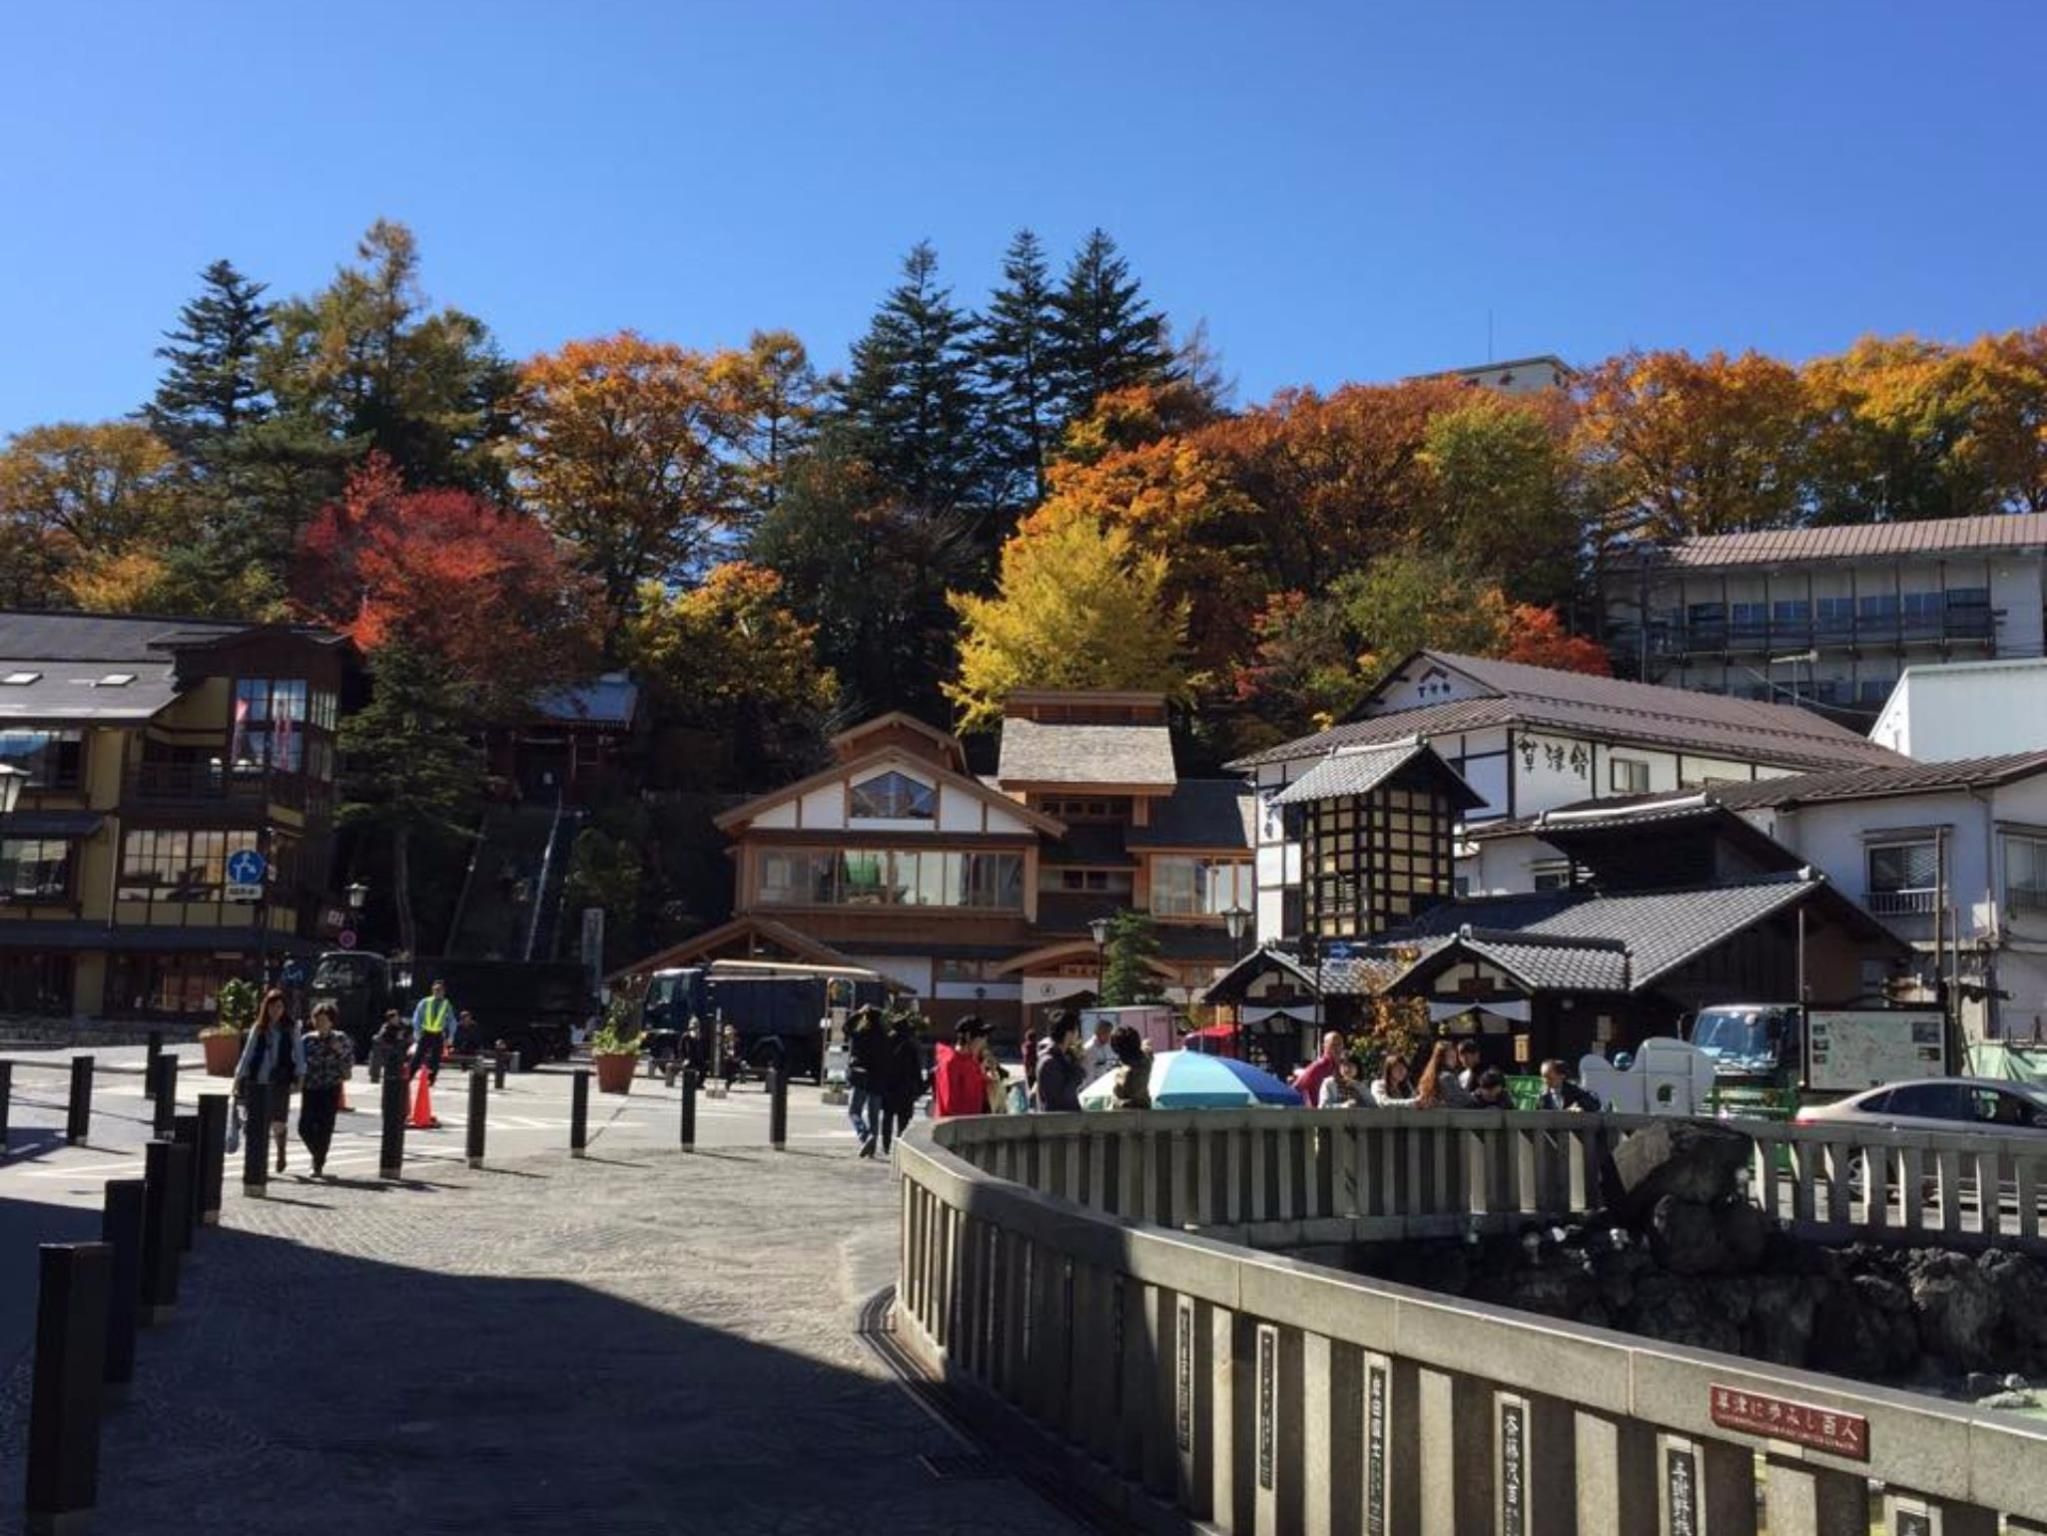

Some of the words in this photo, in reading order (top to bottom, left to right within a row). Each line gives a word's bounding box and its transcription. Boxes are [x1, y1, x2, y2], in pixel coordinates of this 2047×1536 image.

[1717, 1391, 1858, 1441] 草津に歩みし百人
